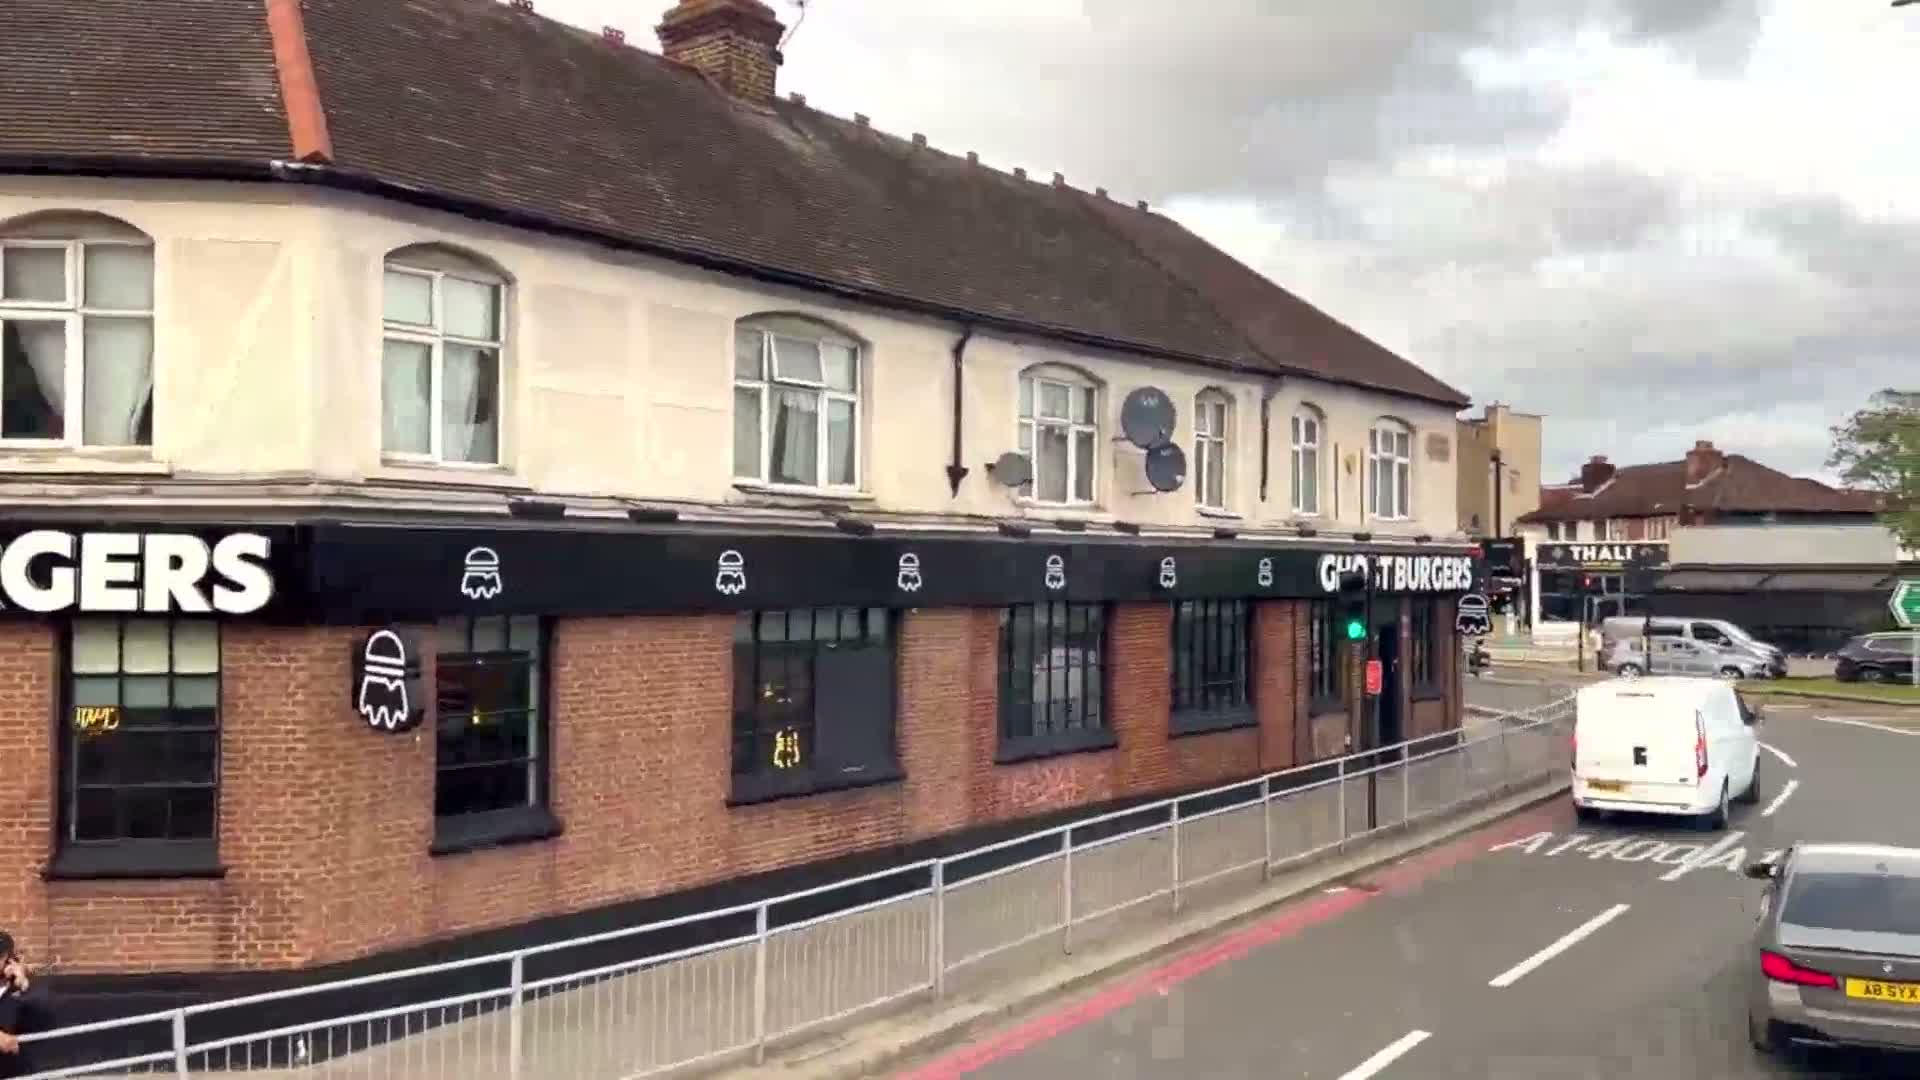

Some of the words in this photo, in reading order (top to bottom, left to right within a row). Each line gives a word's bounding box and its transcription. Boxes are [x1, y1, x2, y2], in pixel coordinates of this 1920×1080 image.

[1569, 545, 1632, 560] THALI
[0, 530, 273, 613] GERS
[1395, 556, 1472, 591] BURGERS
